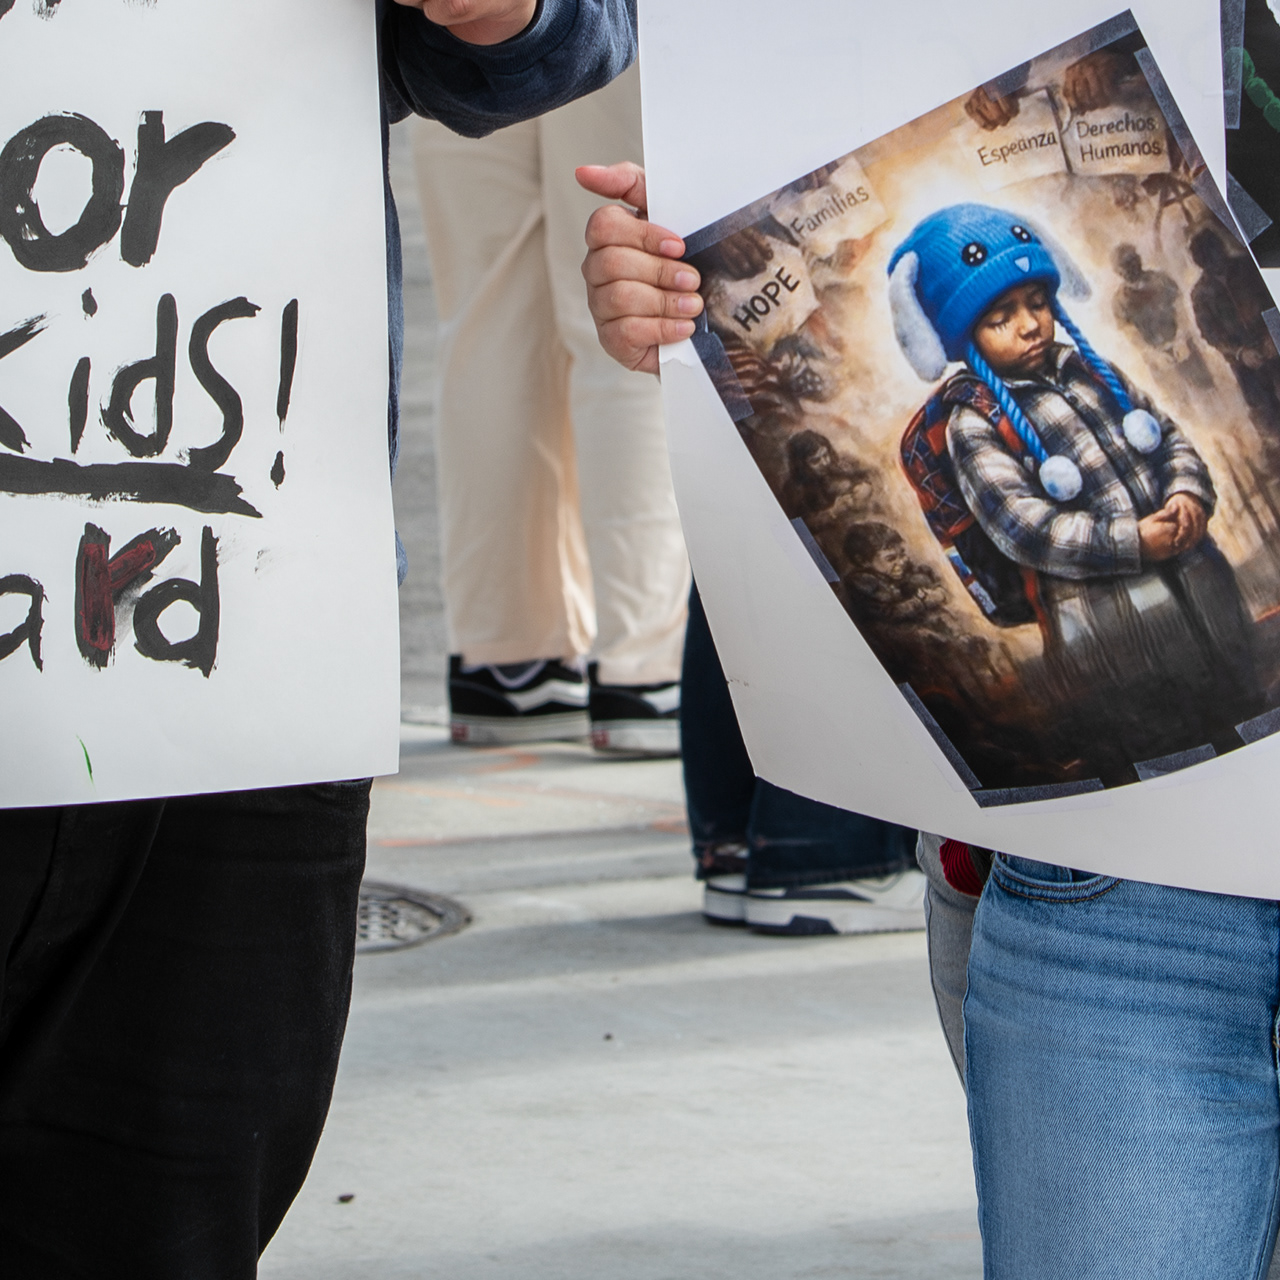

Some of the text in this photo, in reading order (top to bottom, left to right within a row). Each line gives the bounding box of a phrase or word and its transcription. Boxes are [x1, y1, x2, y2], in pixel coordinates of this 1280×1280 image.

[1077, 112, 1157, 139] Derechos
[1080, 140, 1163, 162] Humanos
[790, 186, 870, 238] Familias
[732, 266, 801, 332] HOPE
